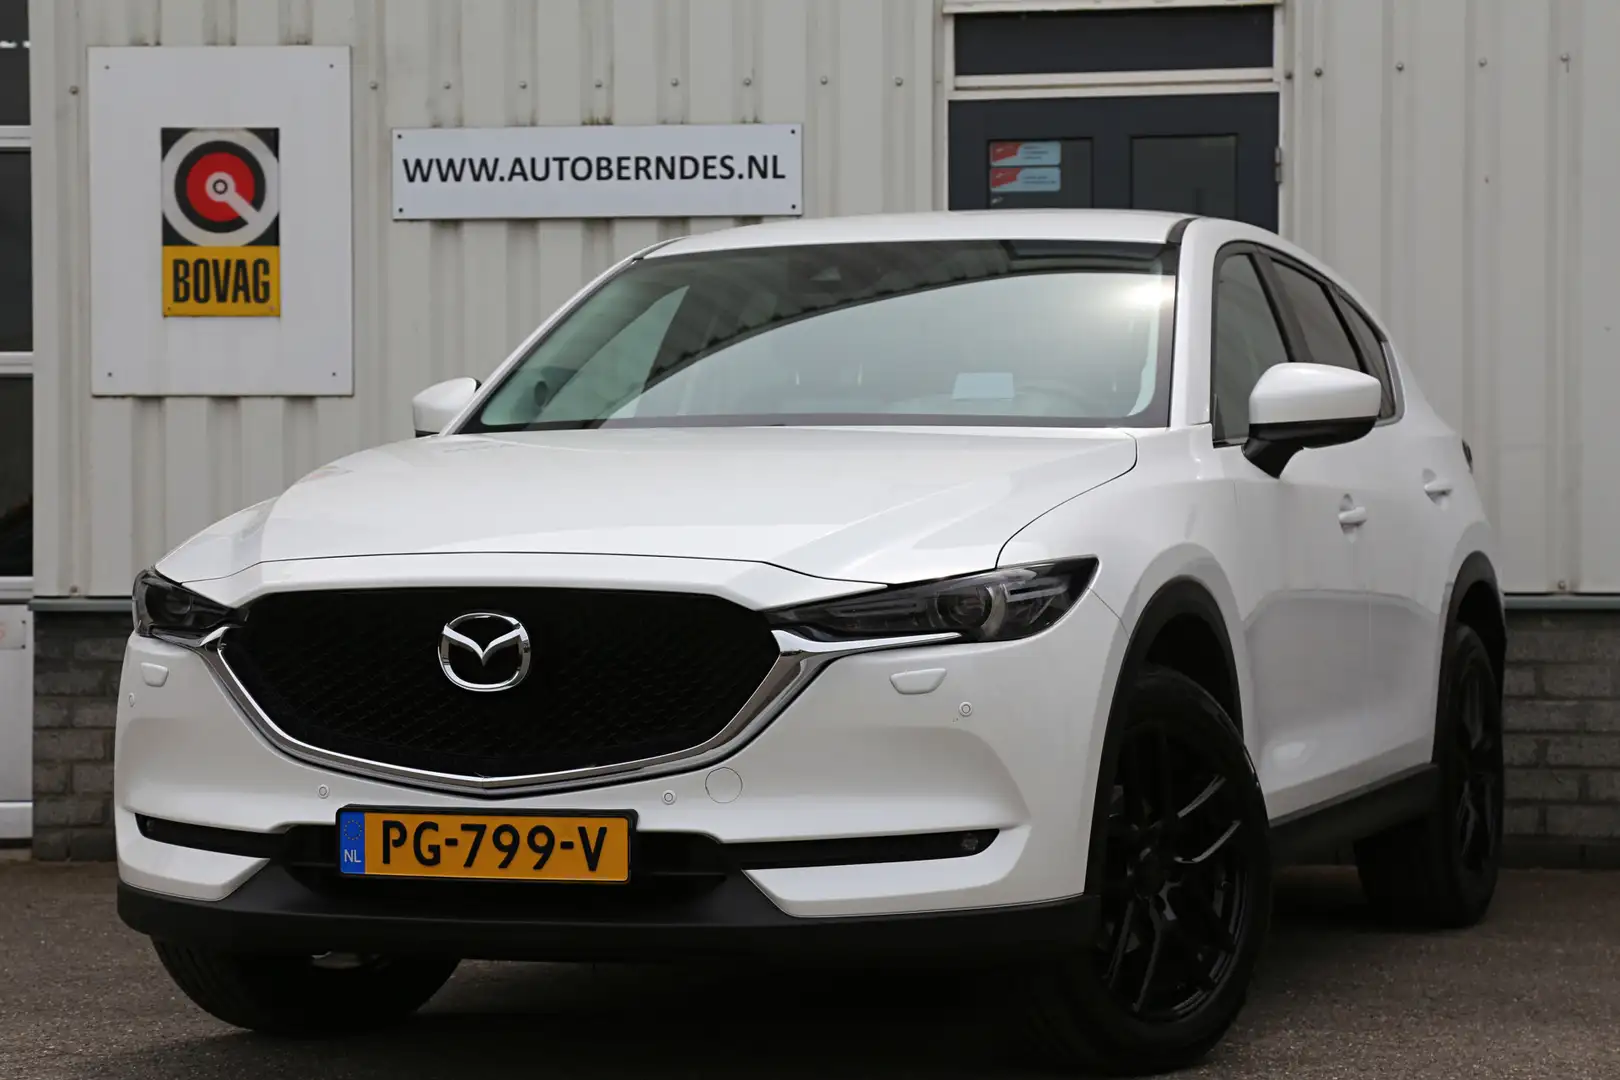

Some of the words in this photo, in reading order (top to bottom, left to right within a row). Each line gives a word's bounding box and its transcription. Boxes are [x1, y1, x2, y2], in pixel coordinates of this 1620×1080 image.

[402, 154, 786, 183] WWW.AUTOBERNDES.NL
[172, 258, 271, 304] BOVAG
[344, 849, 362, 864] NL
[382, 820, 608, 872] PG-799-V
